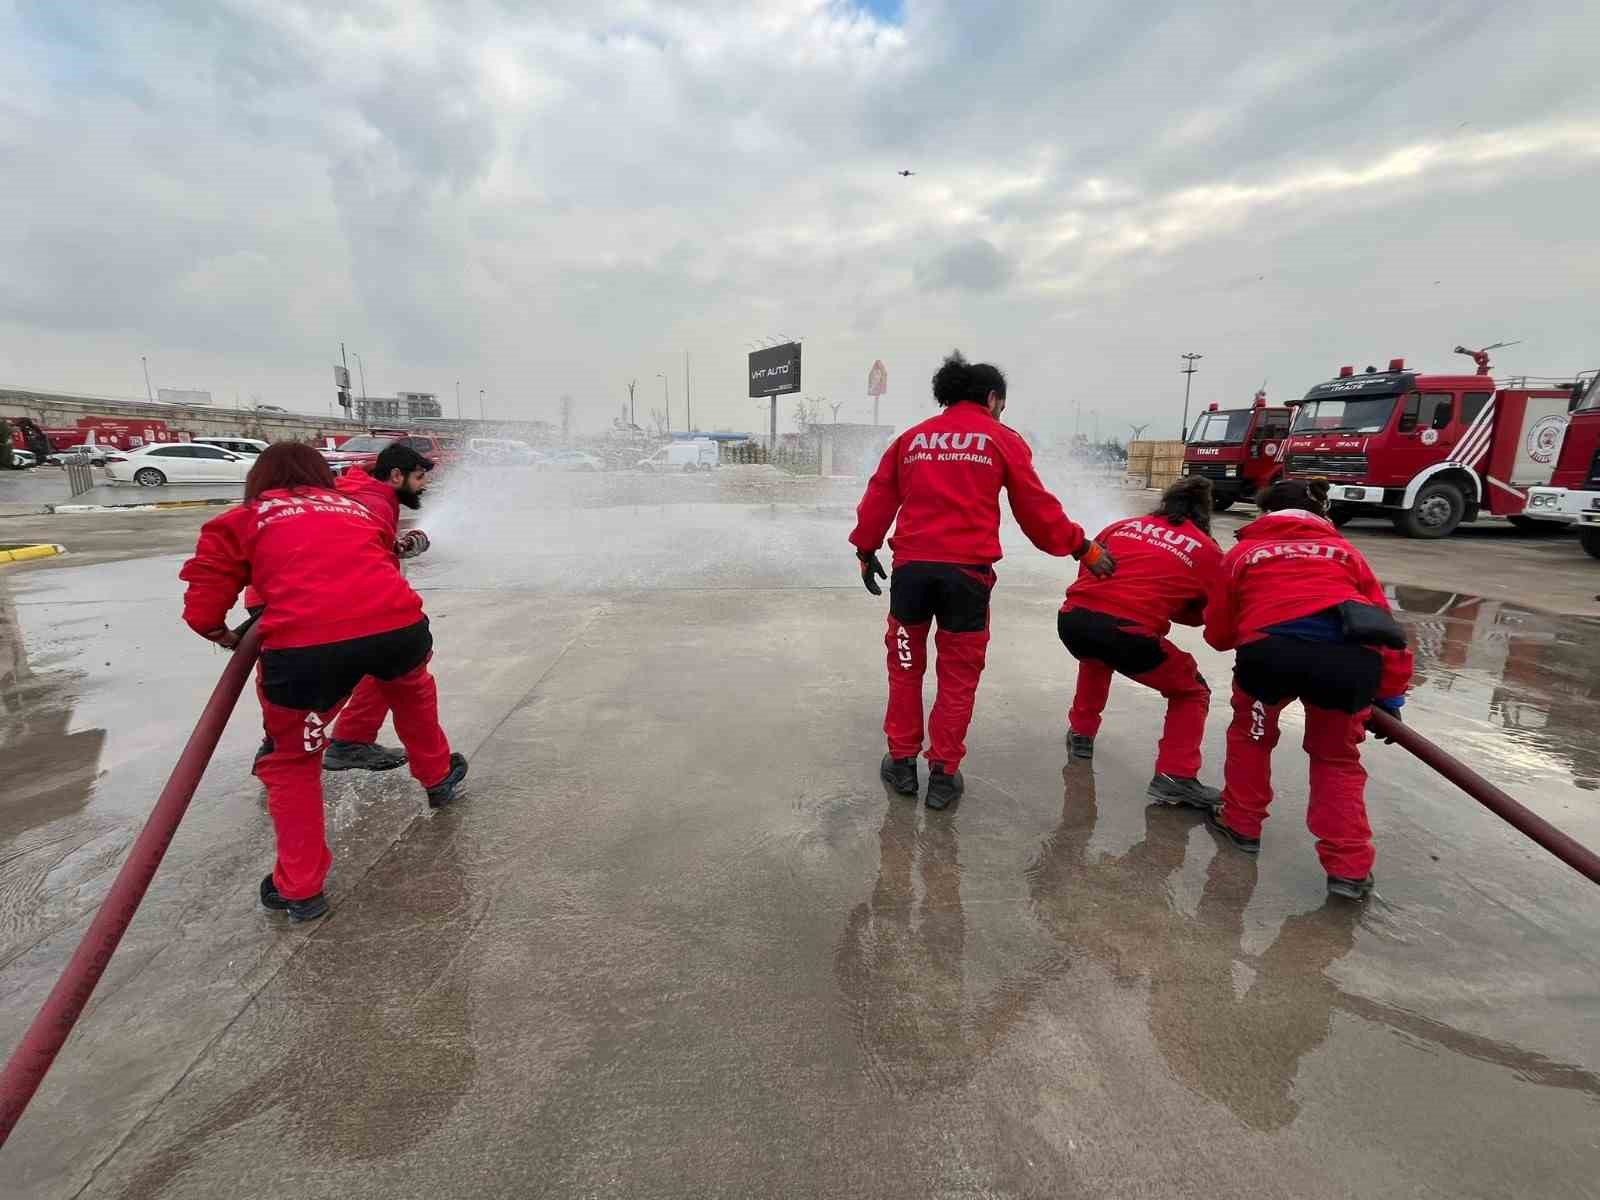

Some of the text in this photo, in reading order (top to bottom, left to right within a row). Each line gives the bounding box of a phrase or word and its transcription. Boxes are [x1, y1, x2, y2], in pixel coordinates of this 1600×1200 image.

[908, 432, 992, 452] AKUT
[937, 452, 993, 466] KURTARMA
[1119, 520, 1203, 553] AKUT
[1146, 538, 1194, 568] KURTARMA
